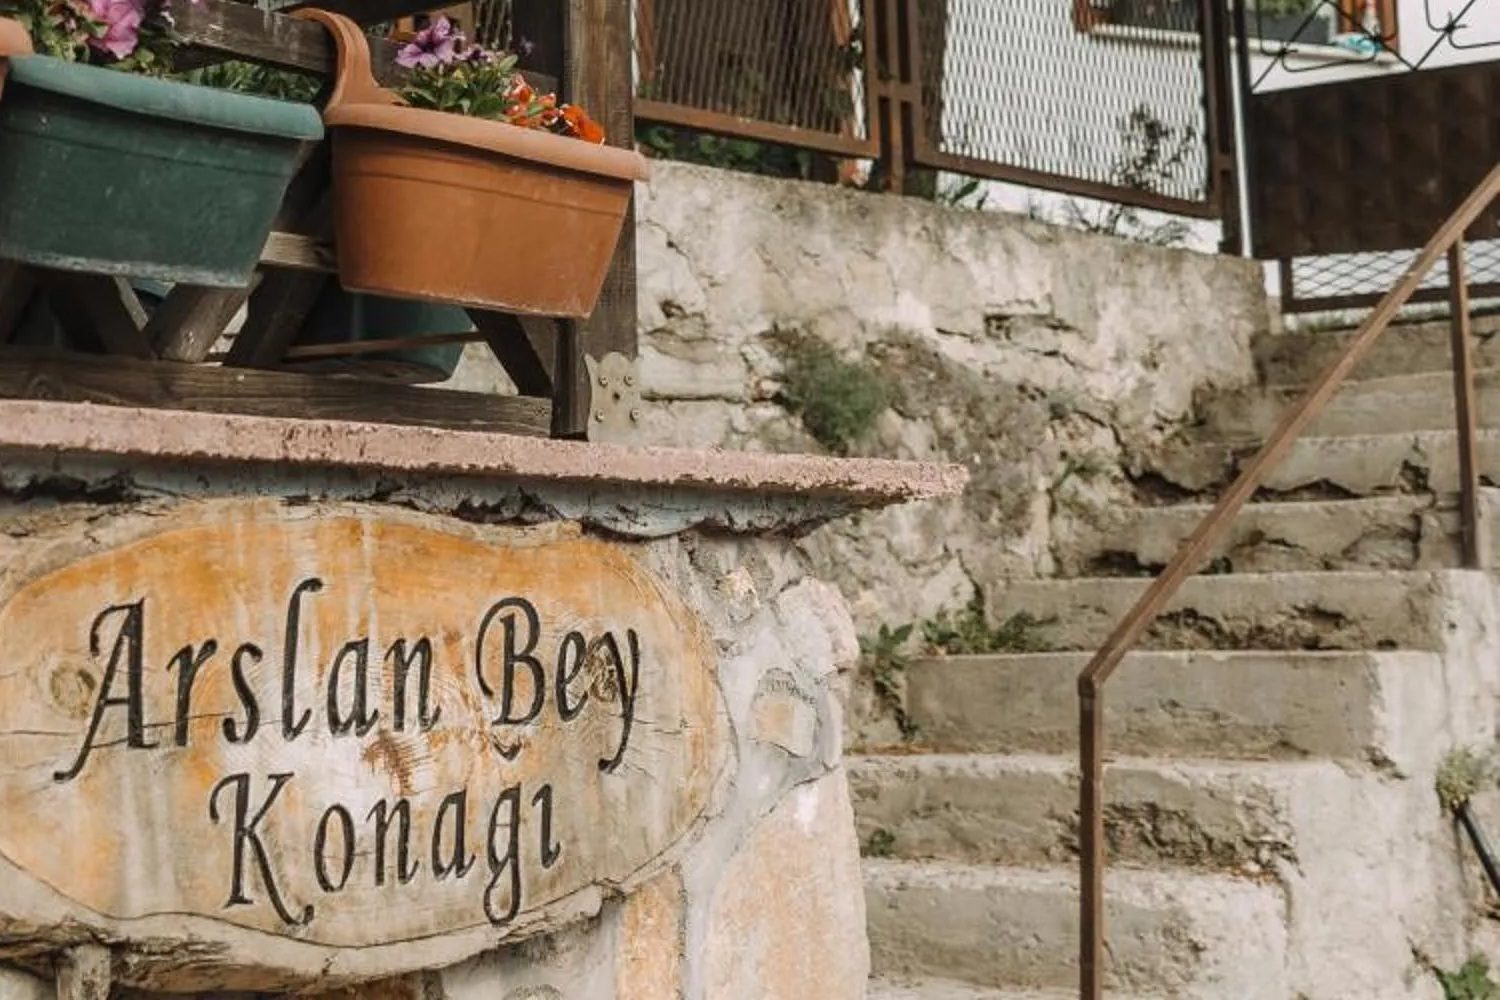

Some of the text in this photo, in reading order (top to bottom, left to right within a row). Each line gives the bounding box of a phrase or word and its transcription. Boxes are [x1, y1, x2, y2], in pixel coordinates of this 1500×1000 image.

[52, 577, 640, 782] Arslan Bey
[209, 738, 561, 926] Konağı
